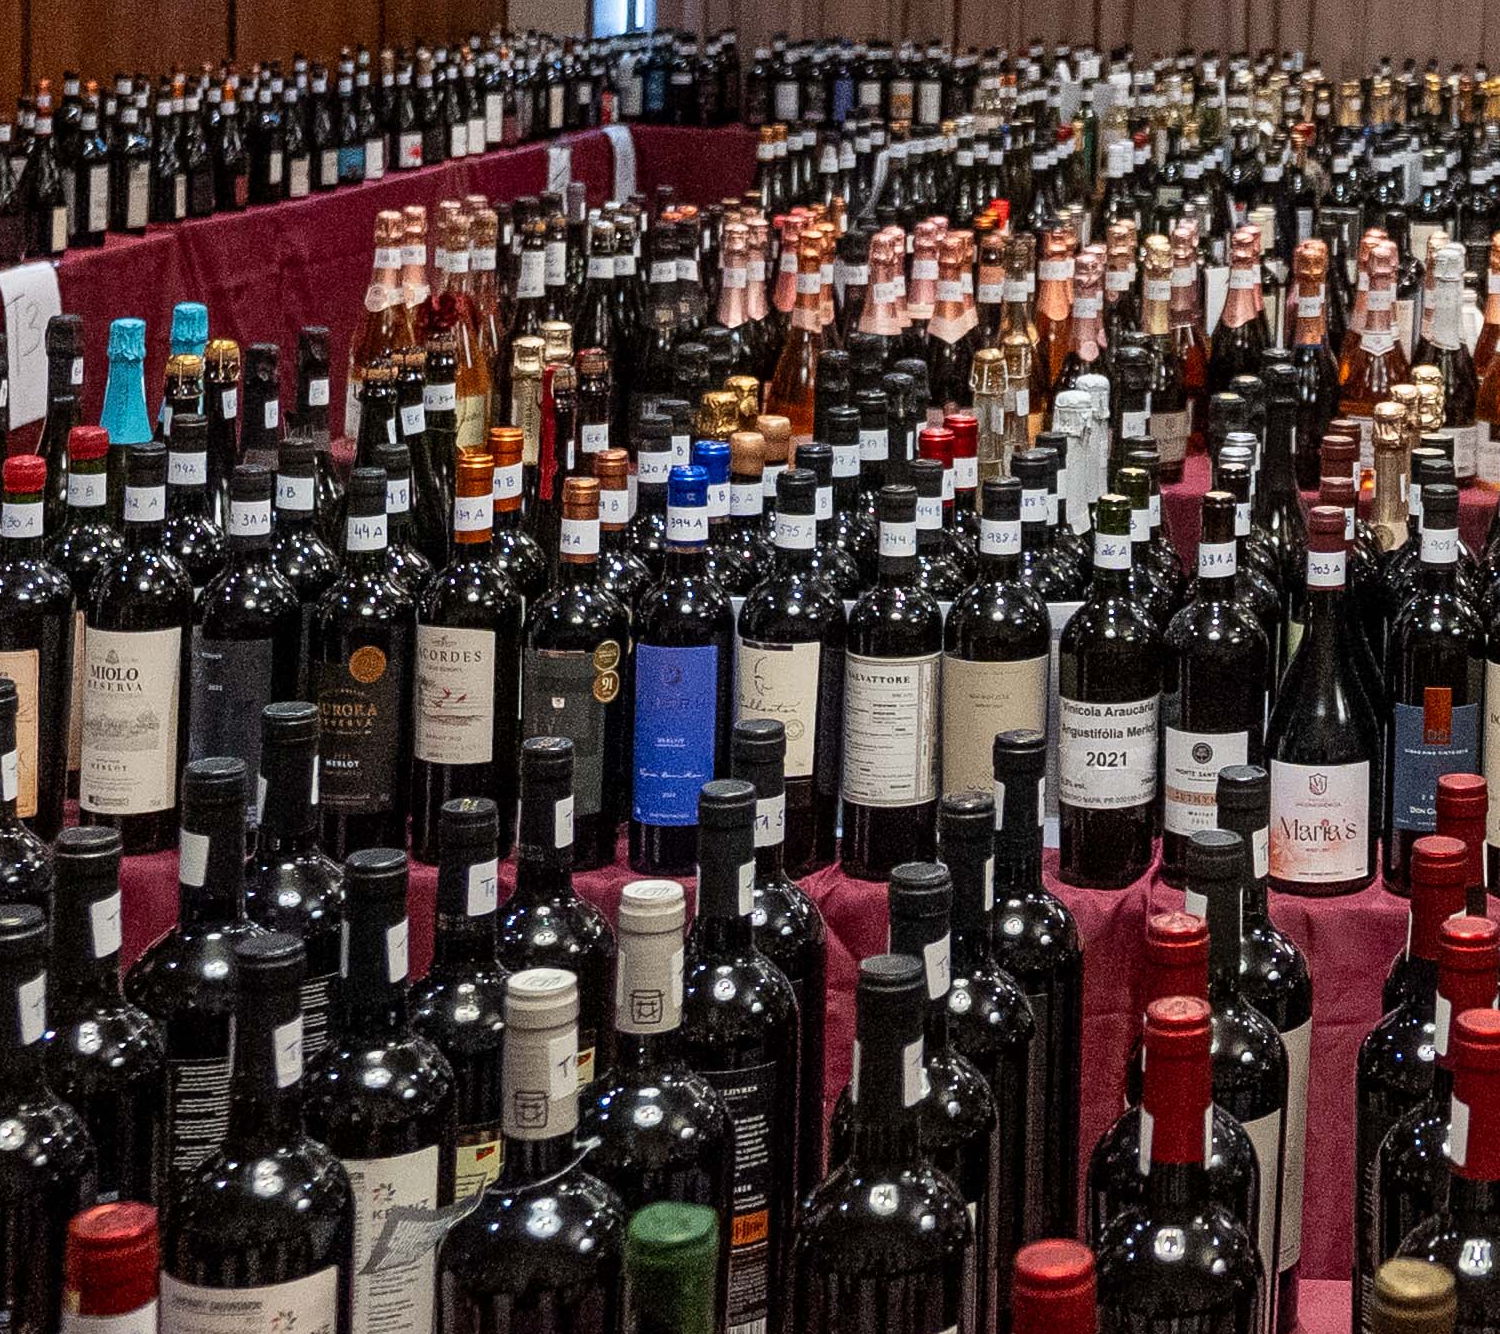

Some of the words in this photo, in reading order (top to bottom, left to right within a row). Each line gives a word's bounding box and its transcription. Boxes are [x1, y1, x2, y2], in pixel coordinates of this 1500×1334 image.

[90, 664, 139, 681] MIOLO
[1085, 751, 1129, 768] 2021
[1279, 815, 1358, 842] Maria's
